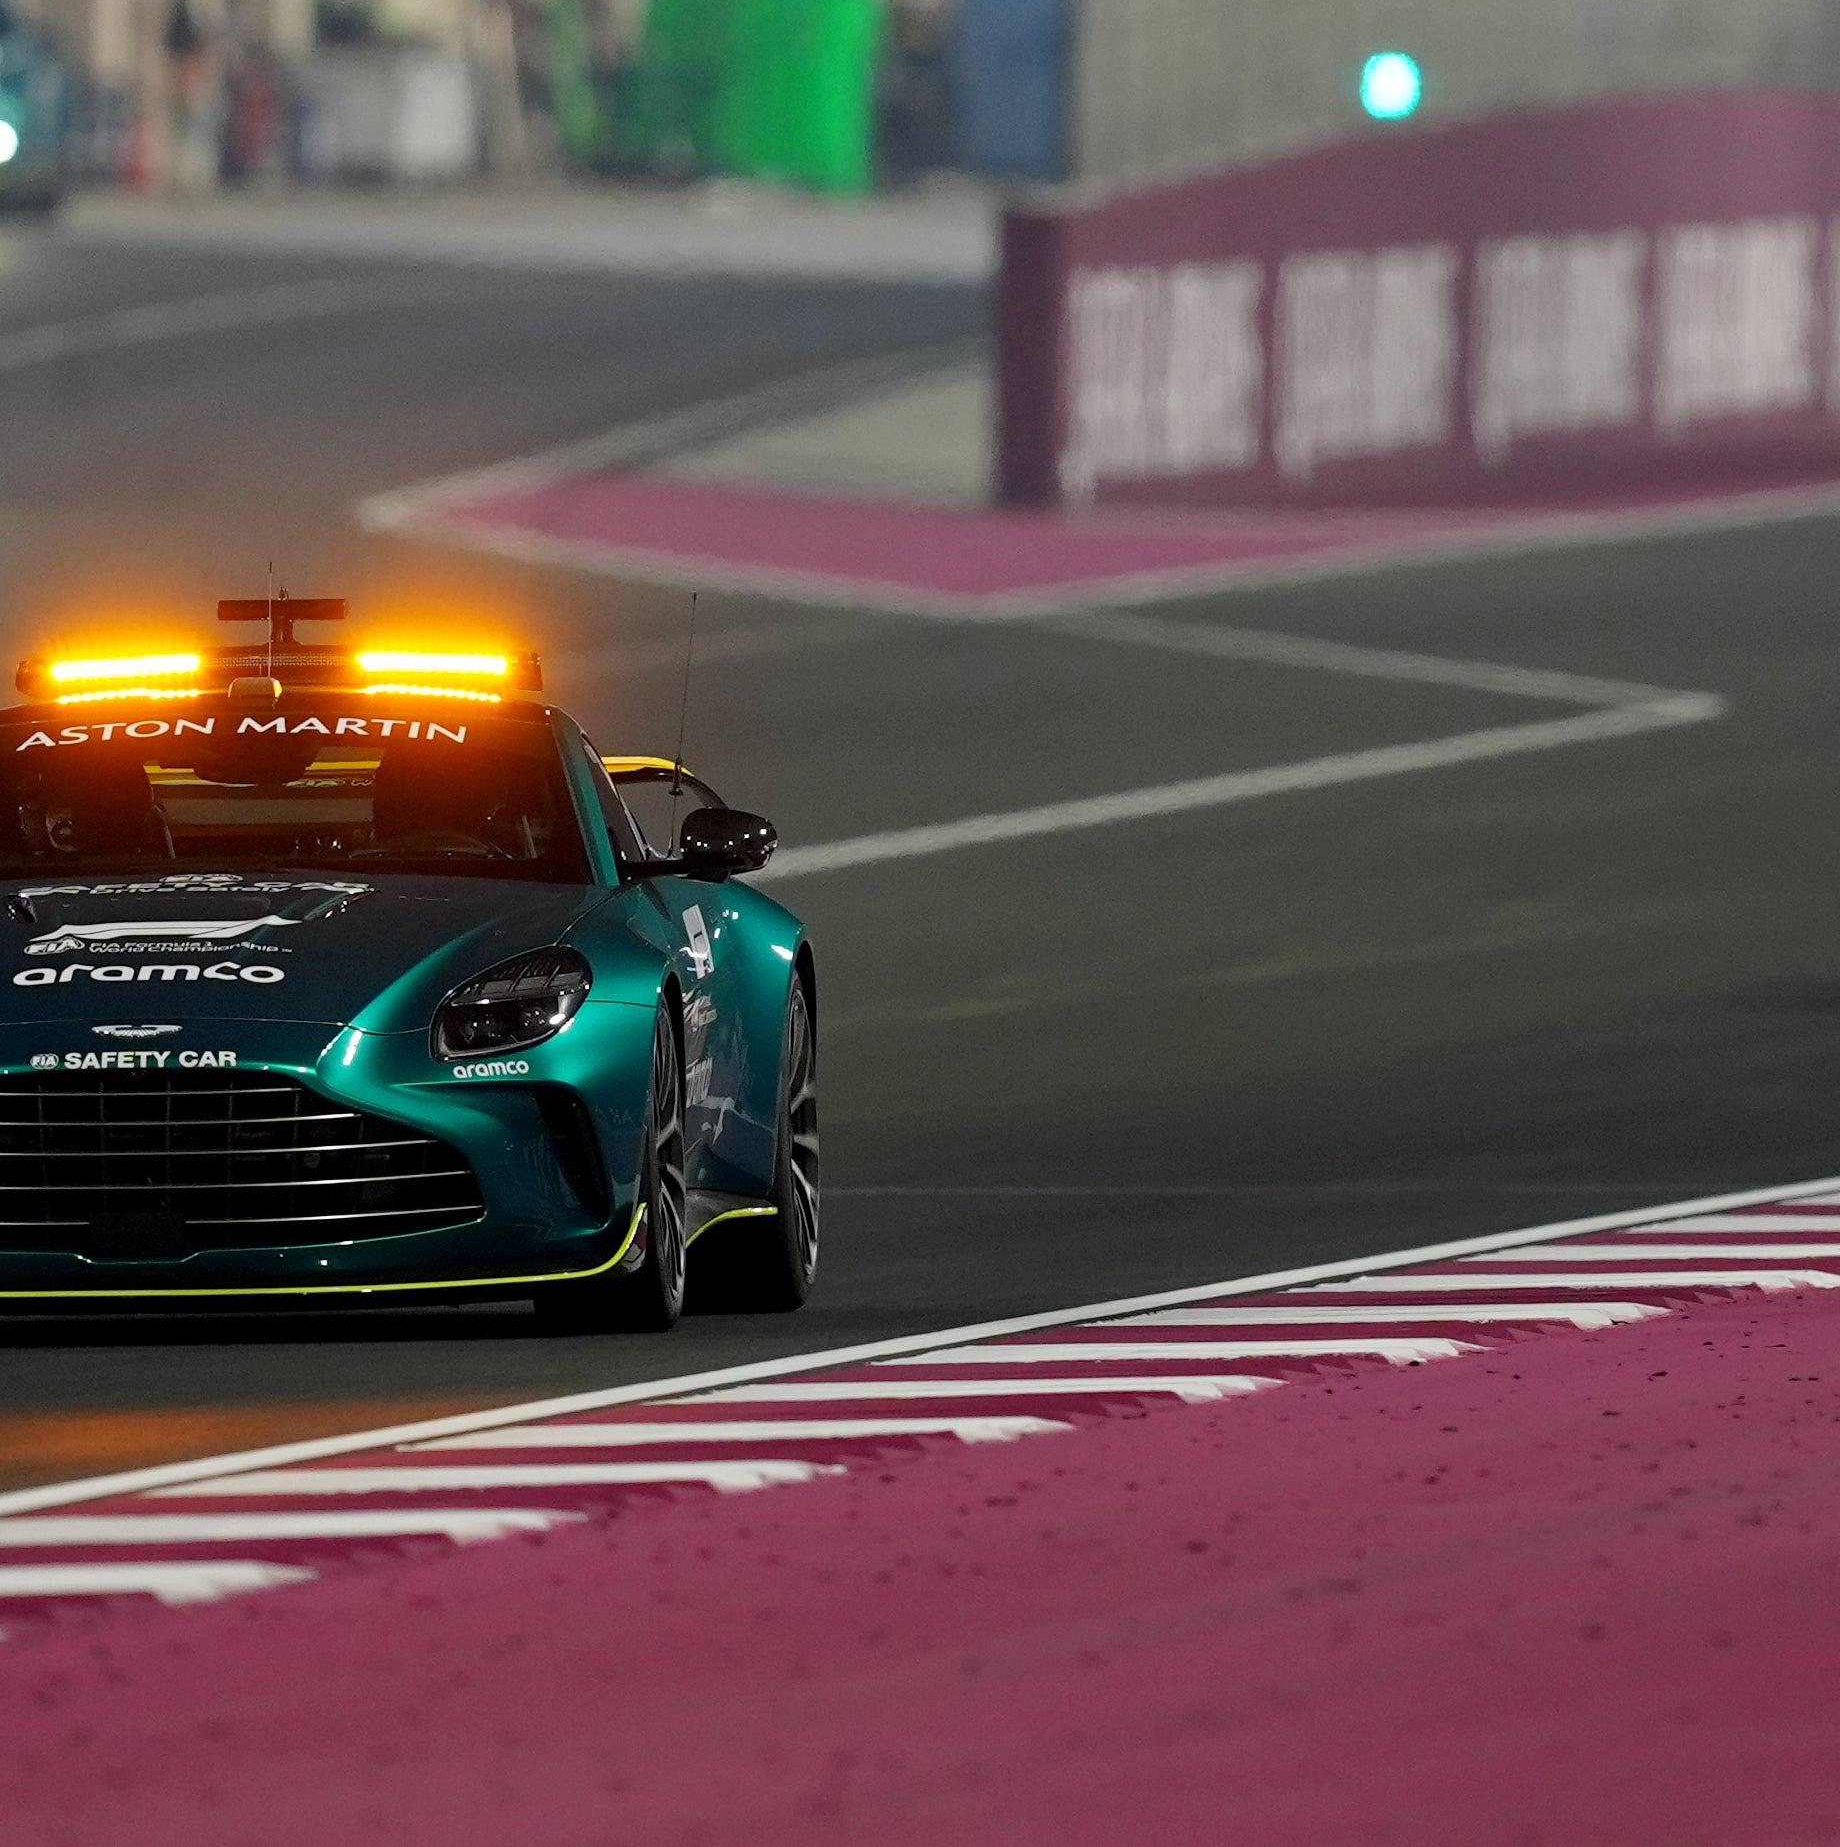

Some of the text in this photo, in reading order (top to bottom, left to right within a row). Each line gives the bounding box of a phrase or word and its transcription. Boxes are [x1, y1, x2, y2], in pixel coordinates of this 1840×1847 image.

[16, 716, 467, 752] ASTON MARTIN
[13, 961, 285, 987] aramco
[30, 1049, 237, 1070] FIA SAFETY CAR
[453, 1059, 529, 1079] aramco
